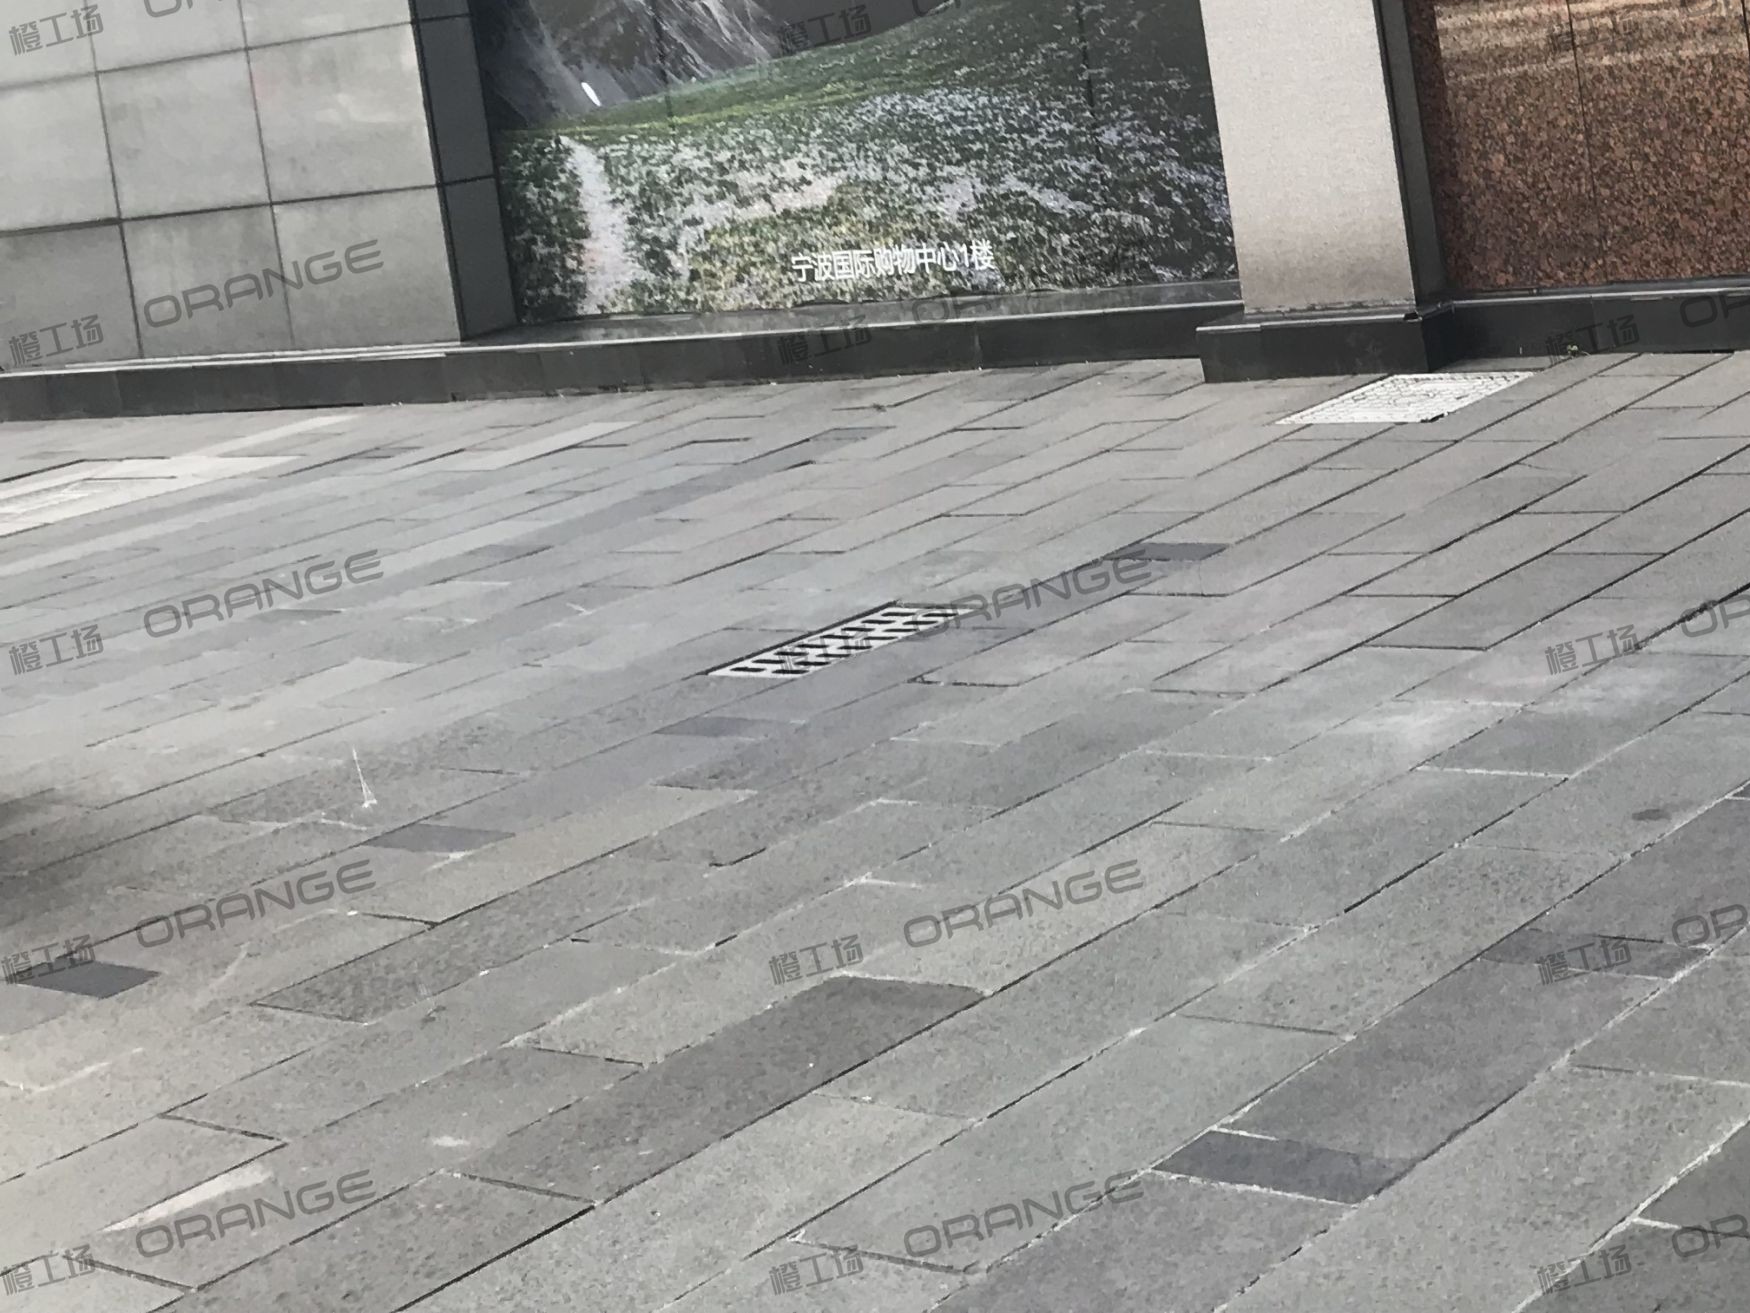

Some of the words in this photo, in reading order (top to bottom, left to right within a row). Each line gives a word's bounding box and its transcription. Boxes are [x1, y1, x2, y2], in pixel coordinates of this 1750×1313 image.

[791, 239, 996, 283] 宁波国际购物中心1楼
